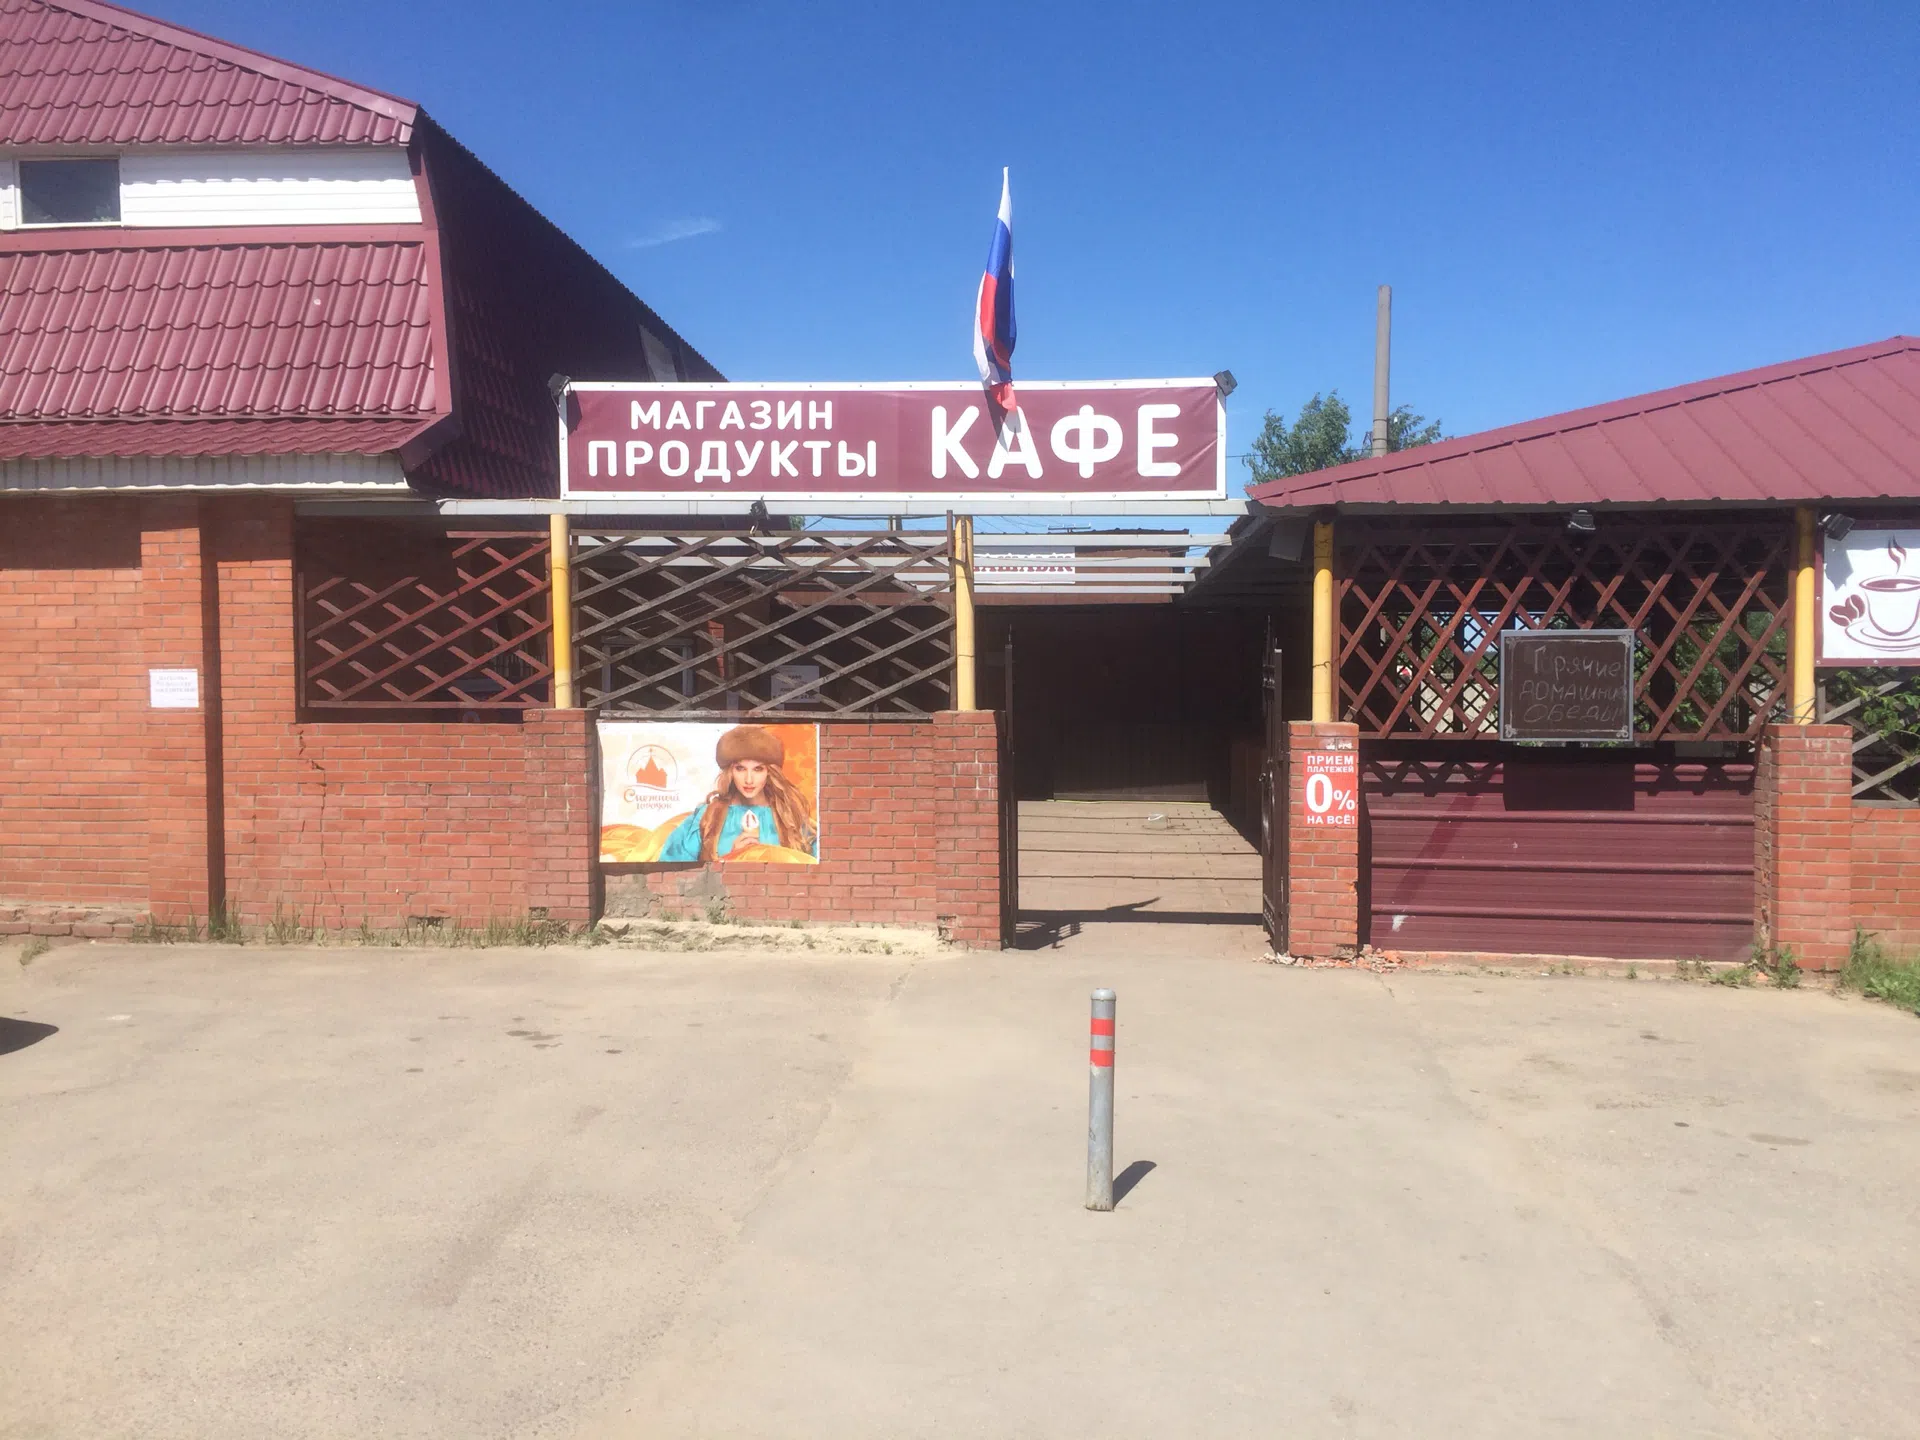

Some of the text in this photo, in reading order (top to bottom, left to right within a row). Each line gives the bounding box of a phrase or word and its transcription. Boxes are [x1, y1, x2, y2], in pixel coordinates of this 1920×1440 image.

[630, 400, 833, 430] МАГАЗИН
[931, 403, 1182, 479] КАФЕ
[588, 440, 877, 483] ПРОДУКТЫ
[1306, 765, 1354, 773] ПЛАТЕЖЕЙ
[1307, 755, 1353, 765] ПРИЕМ
[1306, 773, 1356, 814] 0%
[1306, 815, 1324, 825] НА
